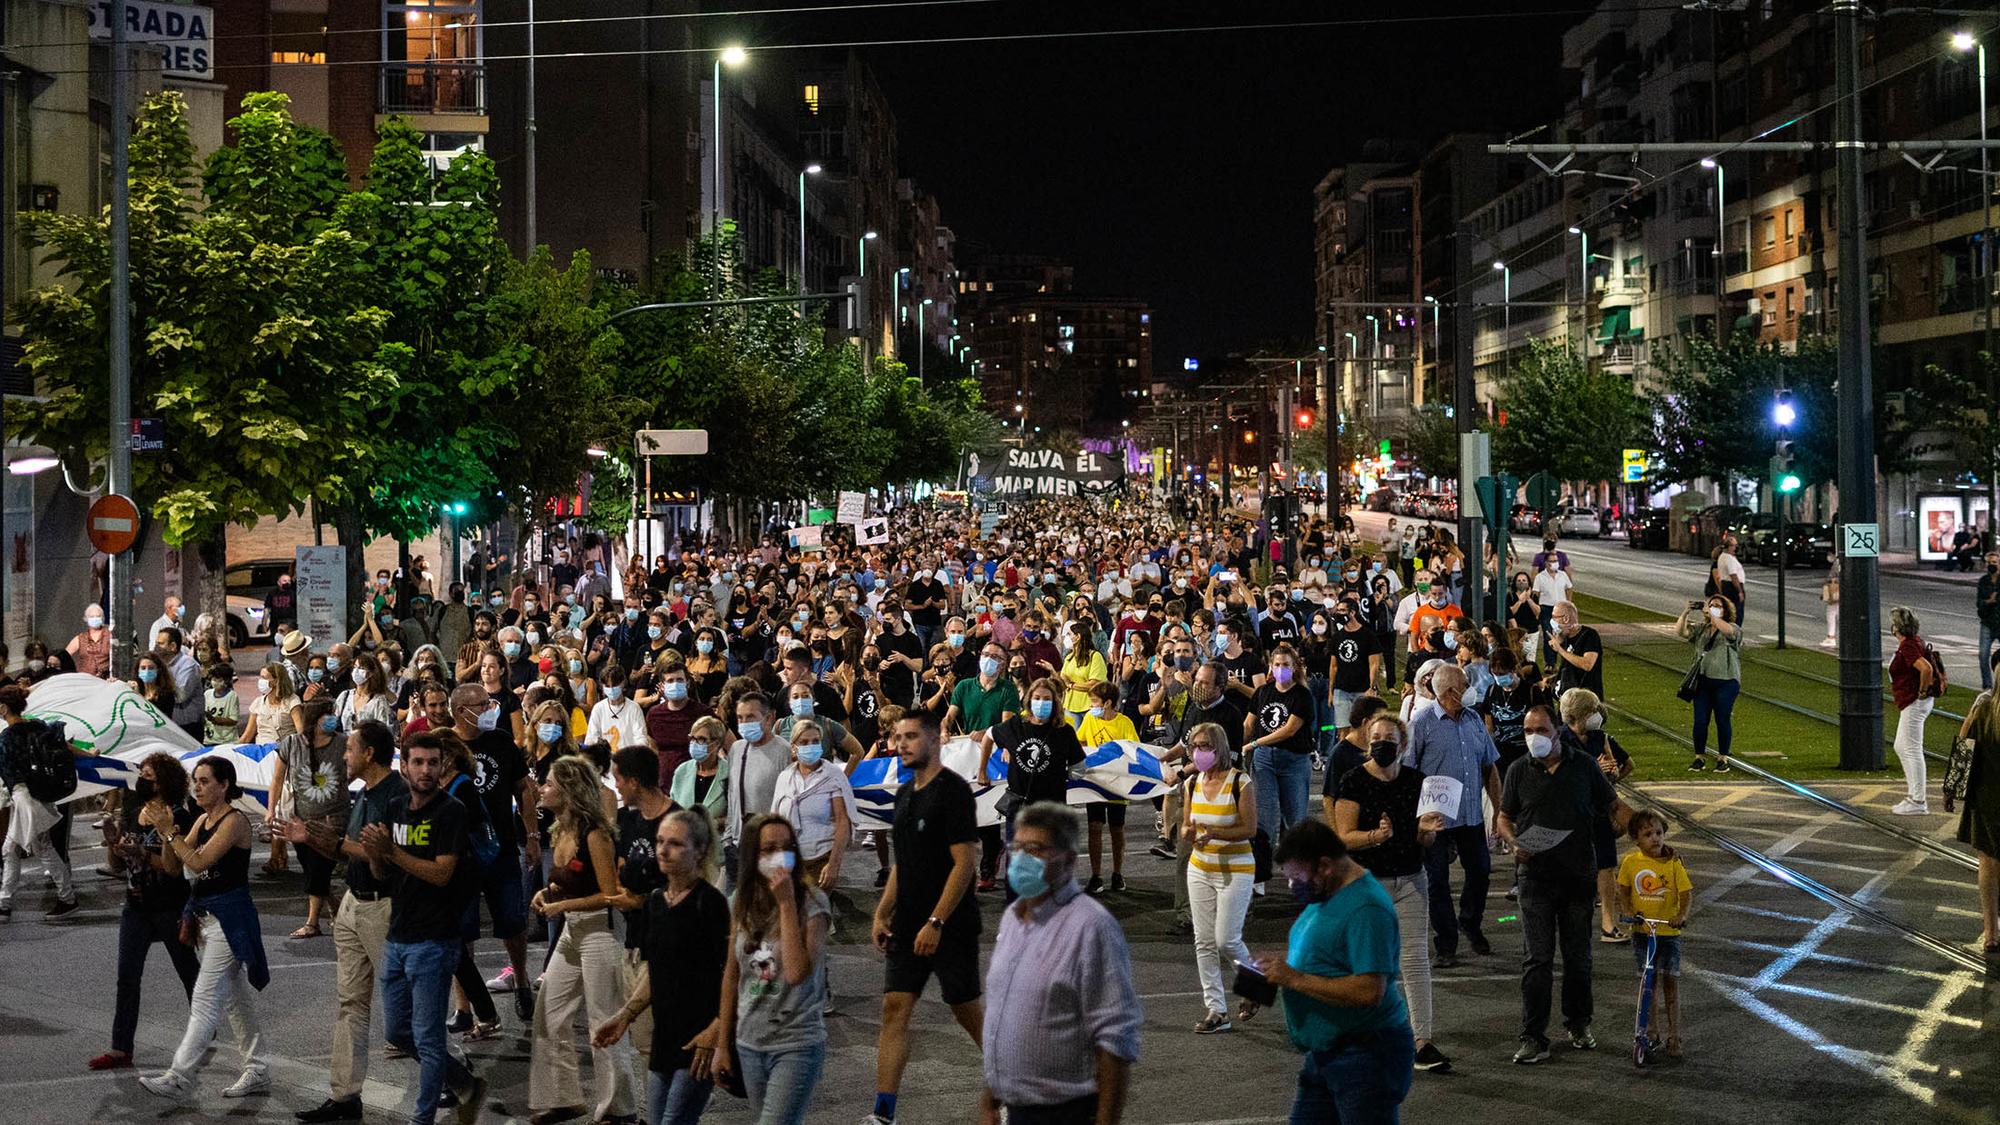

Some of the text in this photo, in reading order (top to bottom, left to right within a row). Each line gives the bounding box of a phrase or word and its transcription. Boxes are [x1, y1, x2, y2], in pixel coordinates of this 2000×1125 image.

[141, 440, 164, 449] LEVANTE
[1009, 450, 1101, 472] SALVA EL
[1851, 532, 1874, 548] 25
[1272, 628, 1293, 640] FILA
[393, 822, 431, 846] NIKE
